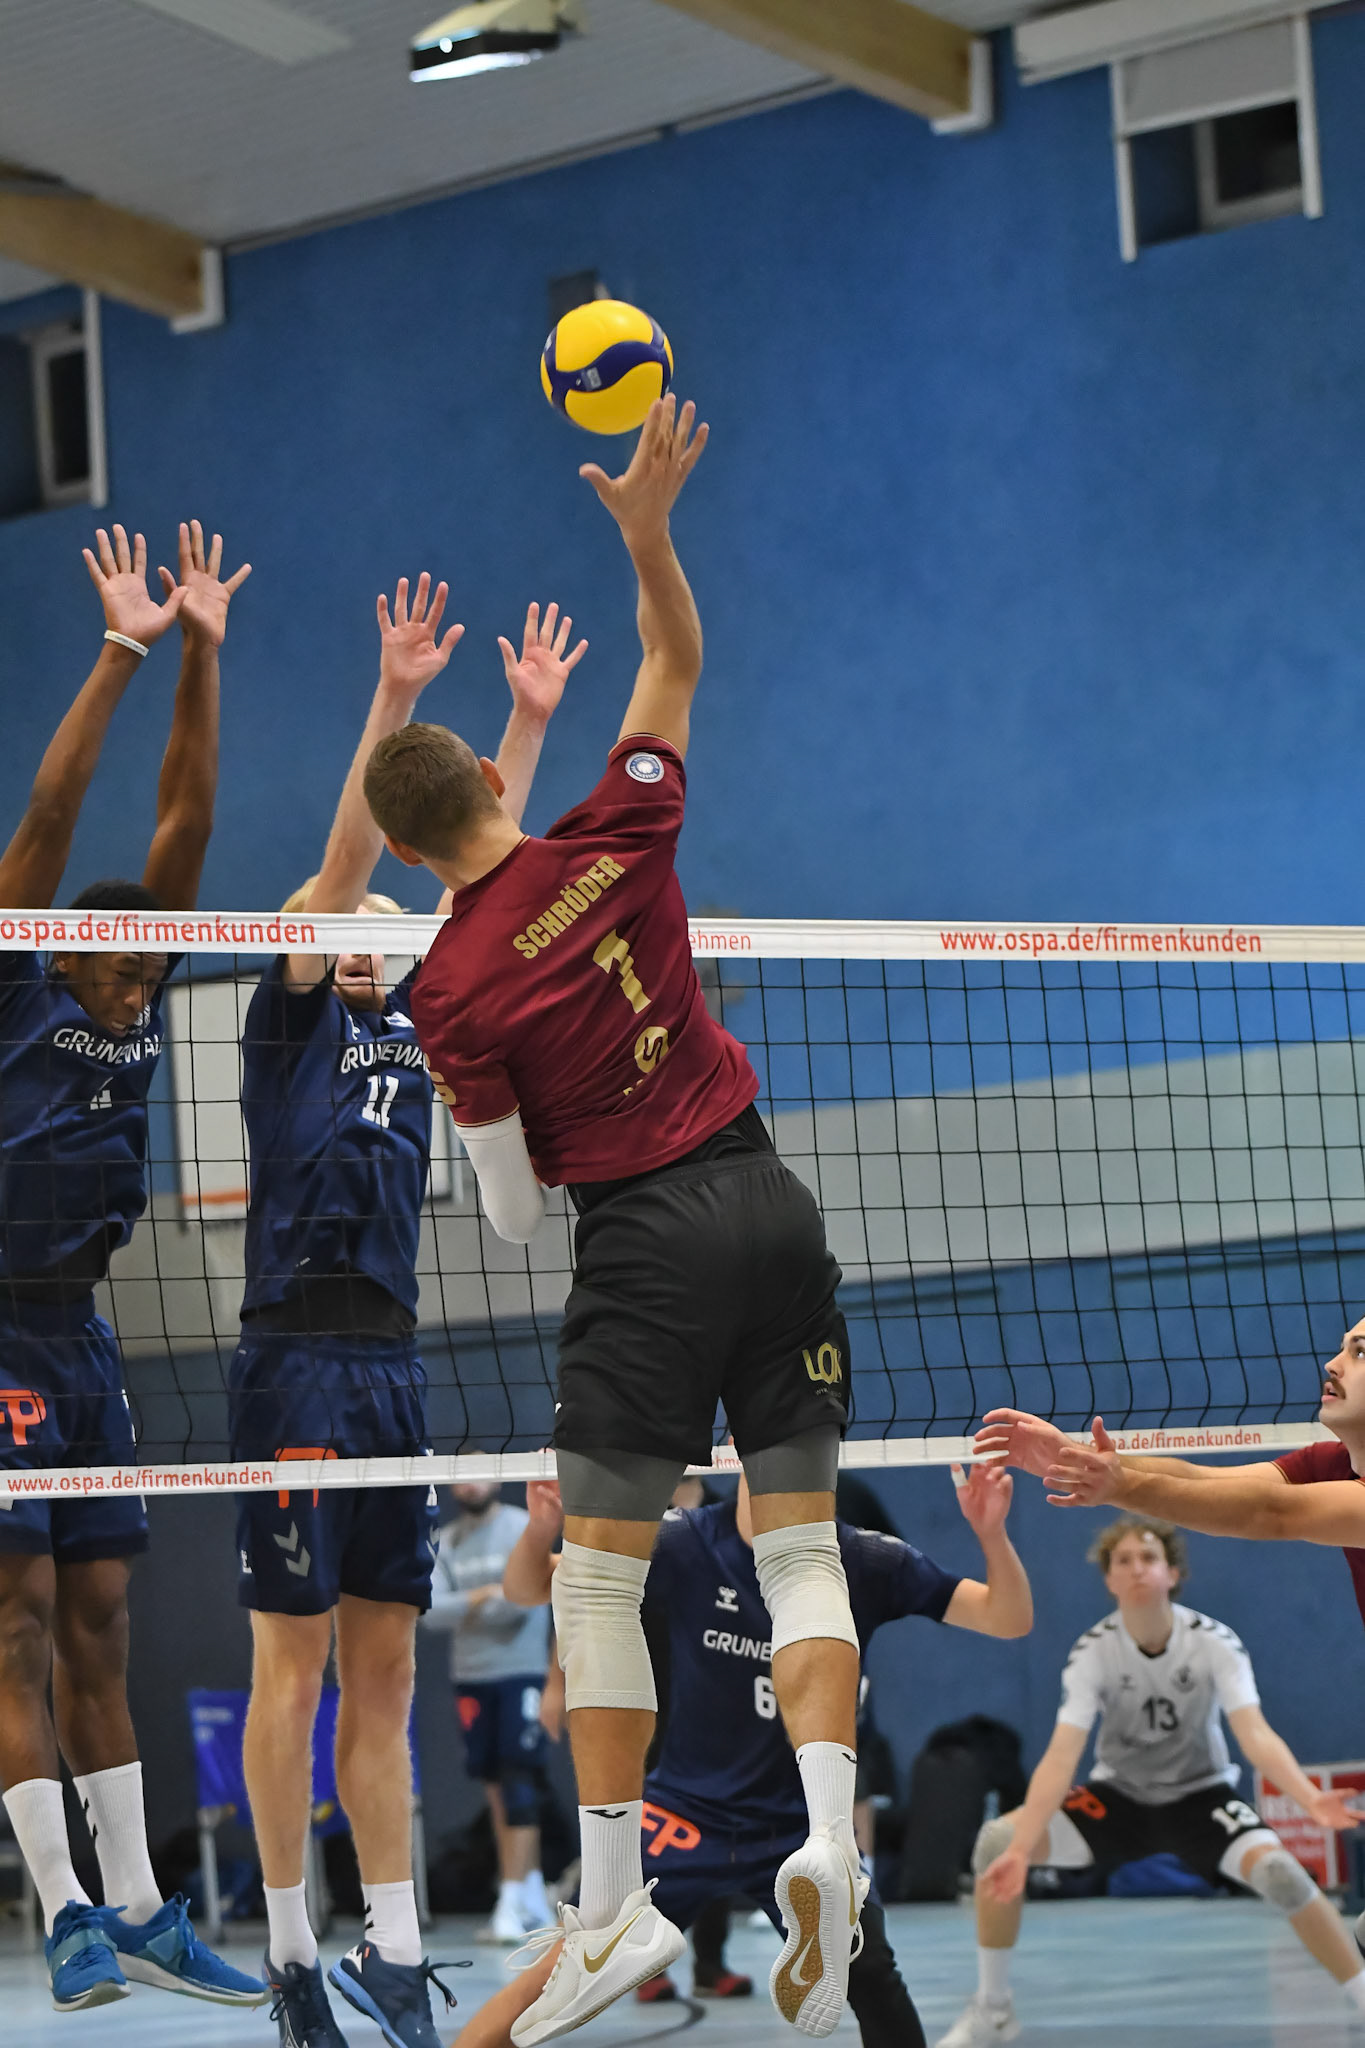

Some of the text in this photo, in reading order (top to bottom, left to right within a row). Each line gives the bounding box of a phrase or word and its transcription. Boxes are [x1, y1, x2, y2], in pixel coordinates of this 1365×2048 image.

[512, 854, 627, 960] SCHRÖDER
[1, 912, 316, 947] ospa.de/firmenkunden
[939, 926, 1262, 957] www.ospa.de/firmenkunden
[361, 1074, 399, 1129] 11
[7, 1466, 273, 1495] www.ospa.de/firmenkunden
[754, 1674, 777, 1720] 6
[1142, 1695, 1179, 1732] 13
